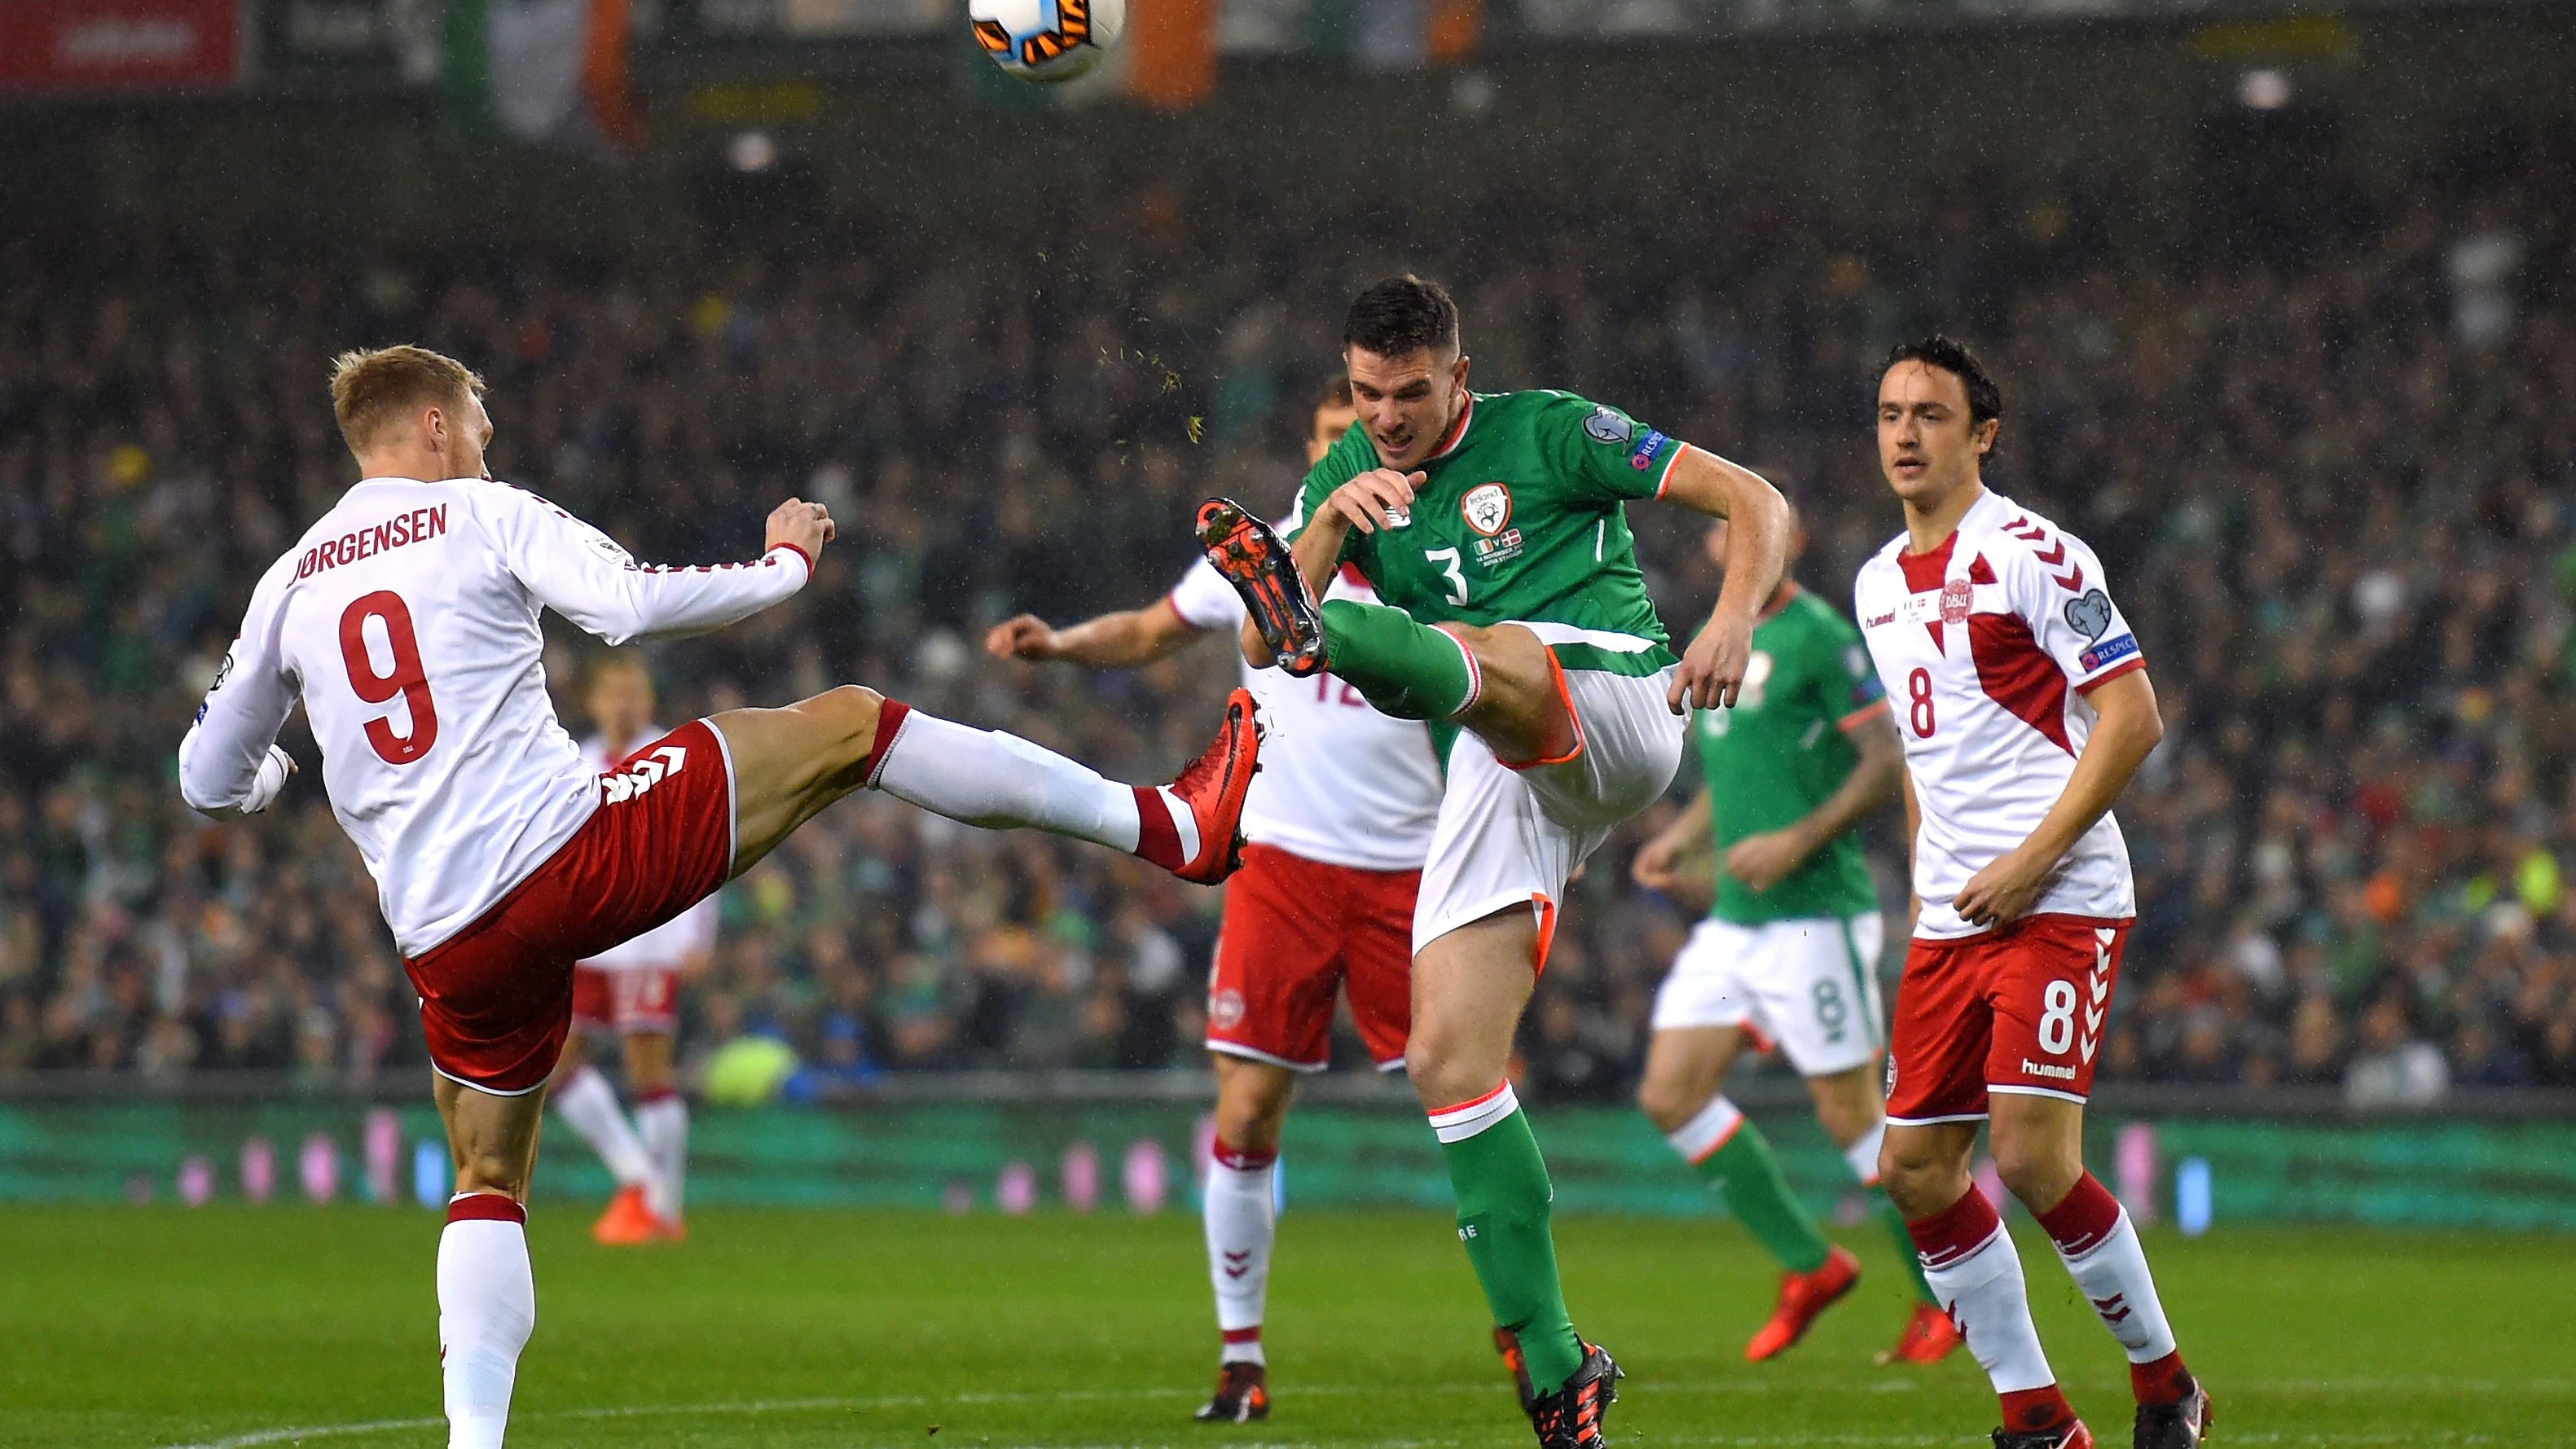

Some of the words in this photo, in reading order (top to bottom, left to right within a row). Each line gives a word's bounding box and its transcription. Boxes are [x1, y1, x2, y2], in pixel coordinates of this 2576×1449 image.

[1468, 490, 1498, 505] Ireland
[286, 503, 447, 589] JØRGENSEN
[1425, 547, 1468, 606] 3
[1945, 593, 1967, 608] DBU
[338, 591, 438, 765] 9
[1909, 666, 1936, 739] 8
[1810, 978, 1847, 1028] 8
[2039, 980, 2077, 1055] 8
[2021, 1057, 2077, 1081] hummel
